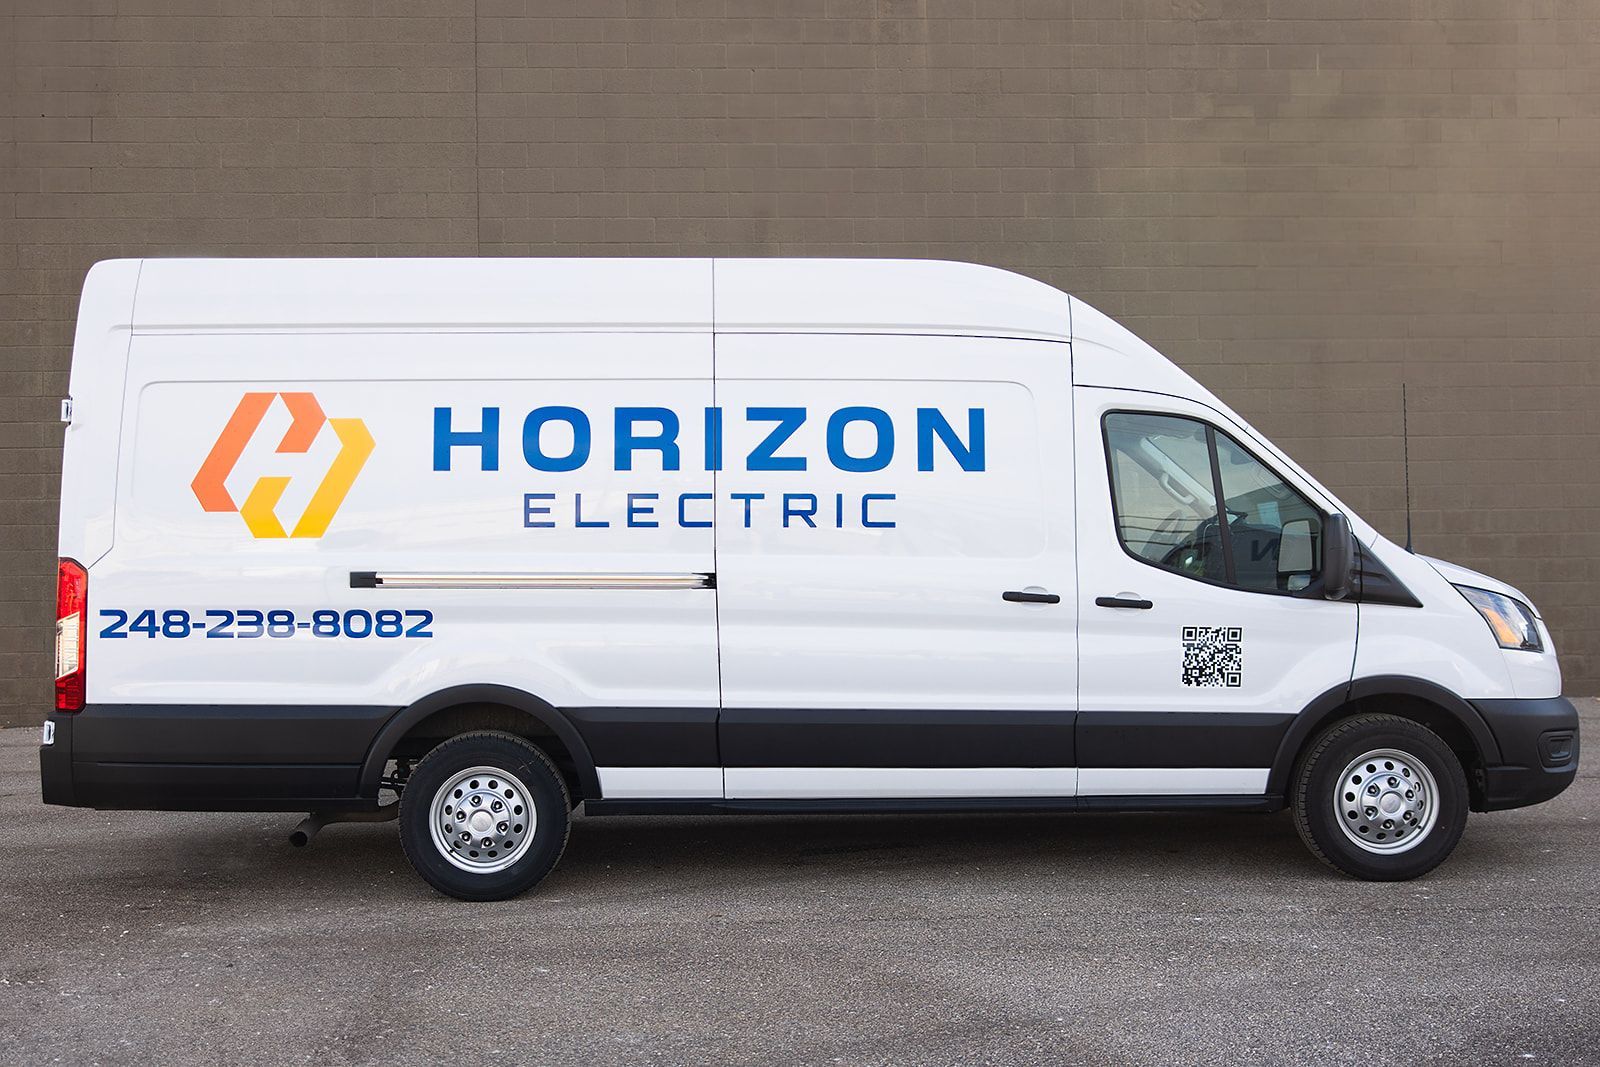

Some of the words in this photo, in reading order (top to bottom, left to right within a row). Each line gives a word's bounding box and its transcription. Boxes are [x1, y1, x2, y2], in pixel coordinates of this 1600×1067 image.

[433, 406, 986, 472] HORIZON
[523, 493, 897, 529] ELECTRIC
[99, 609, 434, 639] 248-238-8082
